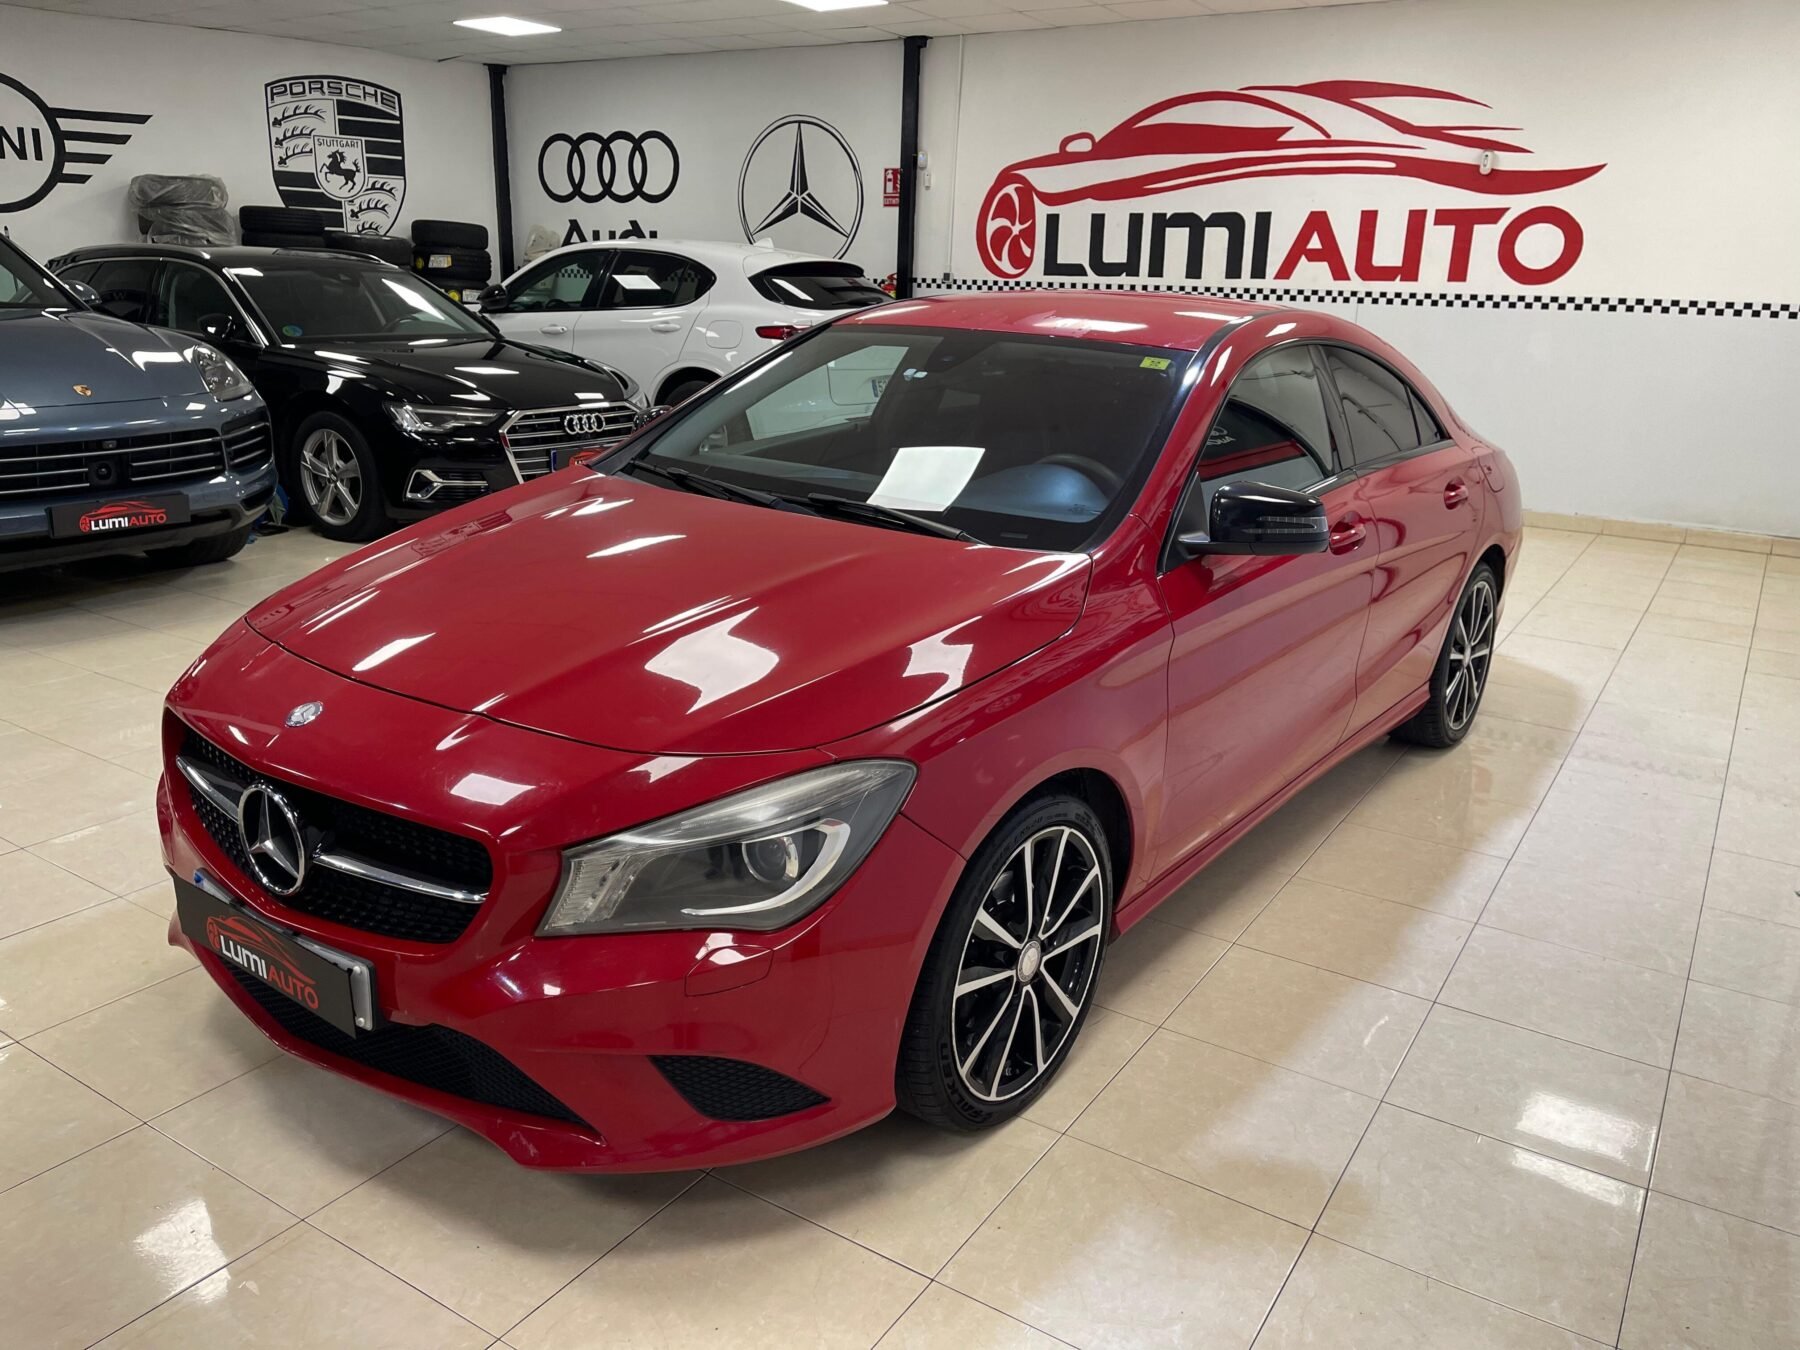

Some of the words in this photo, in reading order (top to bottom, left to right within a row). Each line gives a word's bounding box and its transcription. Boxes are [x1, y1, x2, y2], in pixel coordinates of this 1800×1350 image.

[270, 80, 397, 110] PORSCHE
[316, 138, 359, 148] STUTTGART
[1043, 205, 1584, 285] LUMIAUTO
[91, 514, 166, 530] LUMIAUTO
[220, 935, 319, 1009] LUMIAUTO
